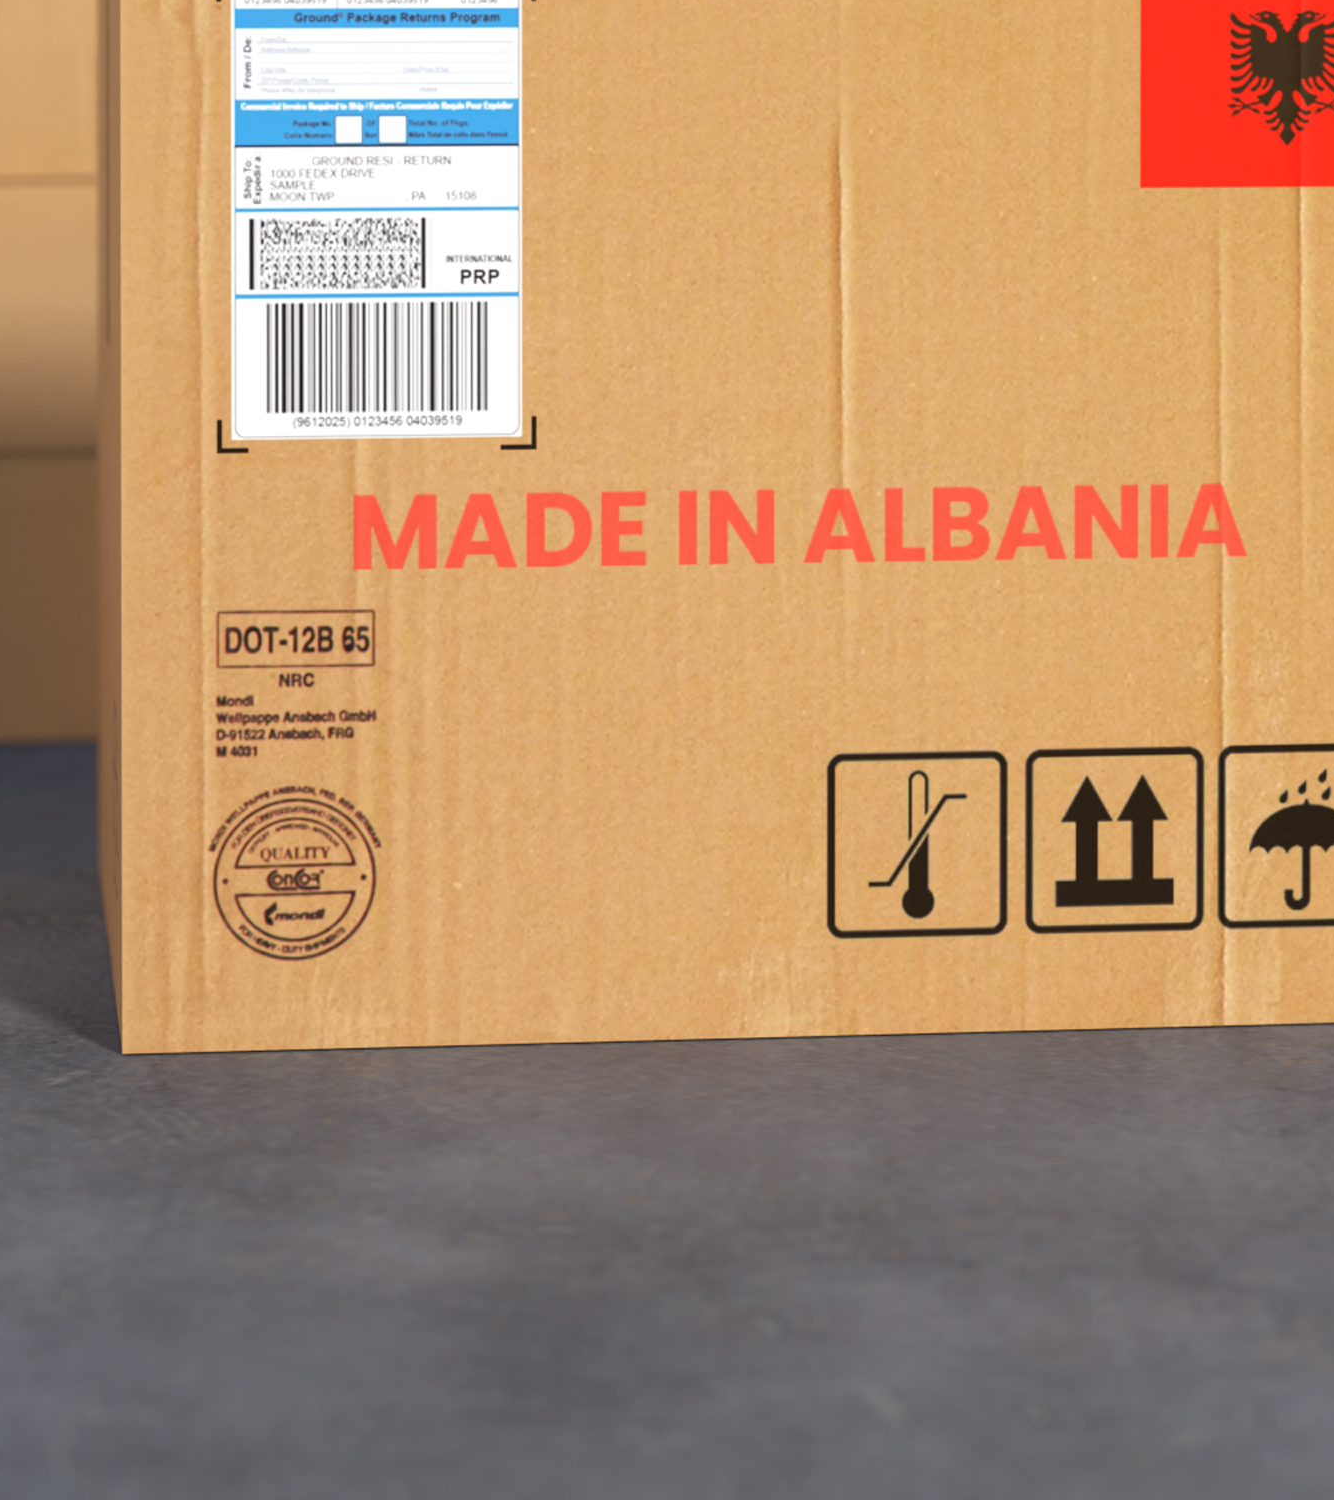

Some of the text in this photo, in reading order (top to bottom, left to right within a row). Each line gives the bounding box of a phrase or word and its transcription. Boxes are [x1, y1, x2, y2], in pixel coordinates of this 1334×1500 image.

[347, 12, 397, 24] Package
[400, 12, 447, 22] Returns
[450, 12, 501, 24] Program
[243, 62, 252, 88] From
[312, 156, 364, 166] GROUND
[366, 156, 393, 165] RESI
[404, 155, 452, 165] RETURN
[270, 168, 375, 179] 1000 FEDEX DRIVE
[270, 180, 316, 191] SAMPLE
[269, 191, 335, 202] MOON TWP
[411, 191, 477, 201] PA 15108
[446, 255, 513, 263] INTERNATIONAL
[460, 269, 501, 285] PRP
[292, 415, 463, 428] (9612025) 0123456 04039519
[352, 483, 1248, 570] MADE IN ALBANIA
[225, 625, 370, 653] DOT-12B 65
[279, 673, 315, 687] NRC
[216, 695, 254, 707] Mondi
[216, 709, 376, 726] Wellpappe Ansbach GmbH
[216, 728, 265, 740] D-91522
[328, 726, 354, 739] FRG
[260, 846, 331, 863] QUALITY
